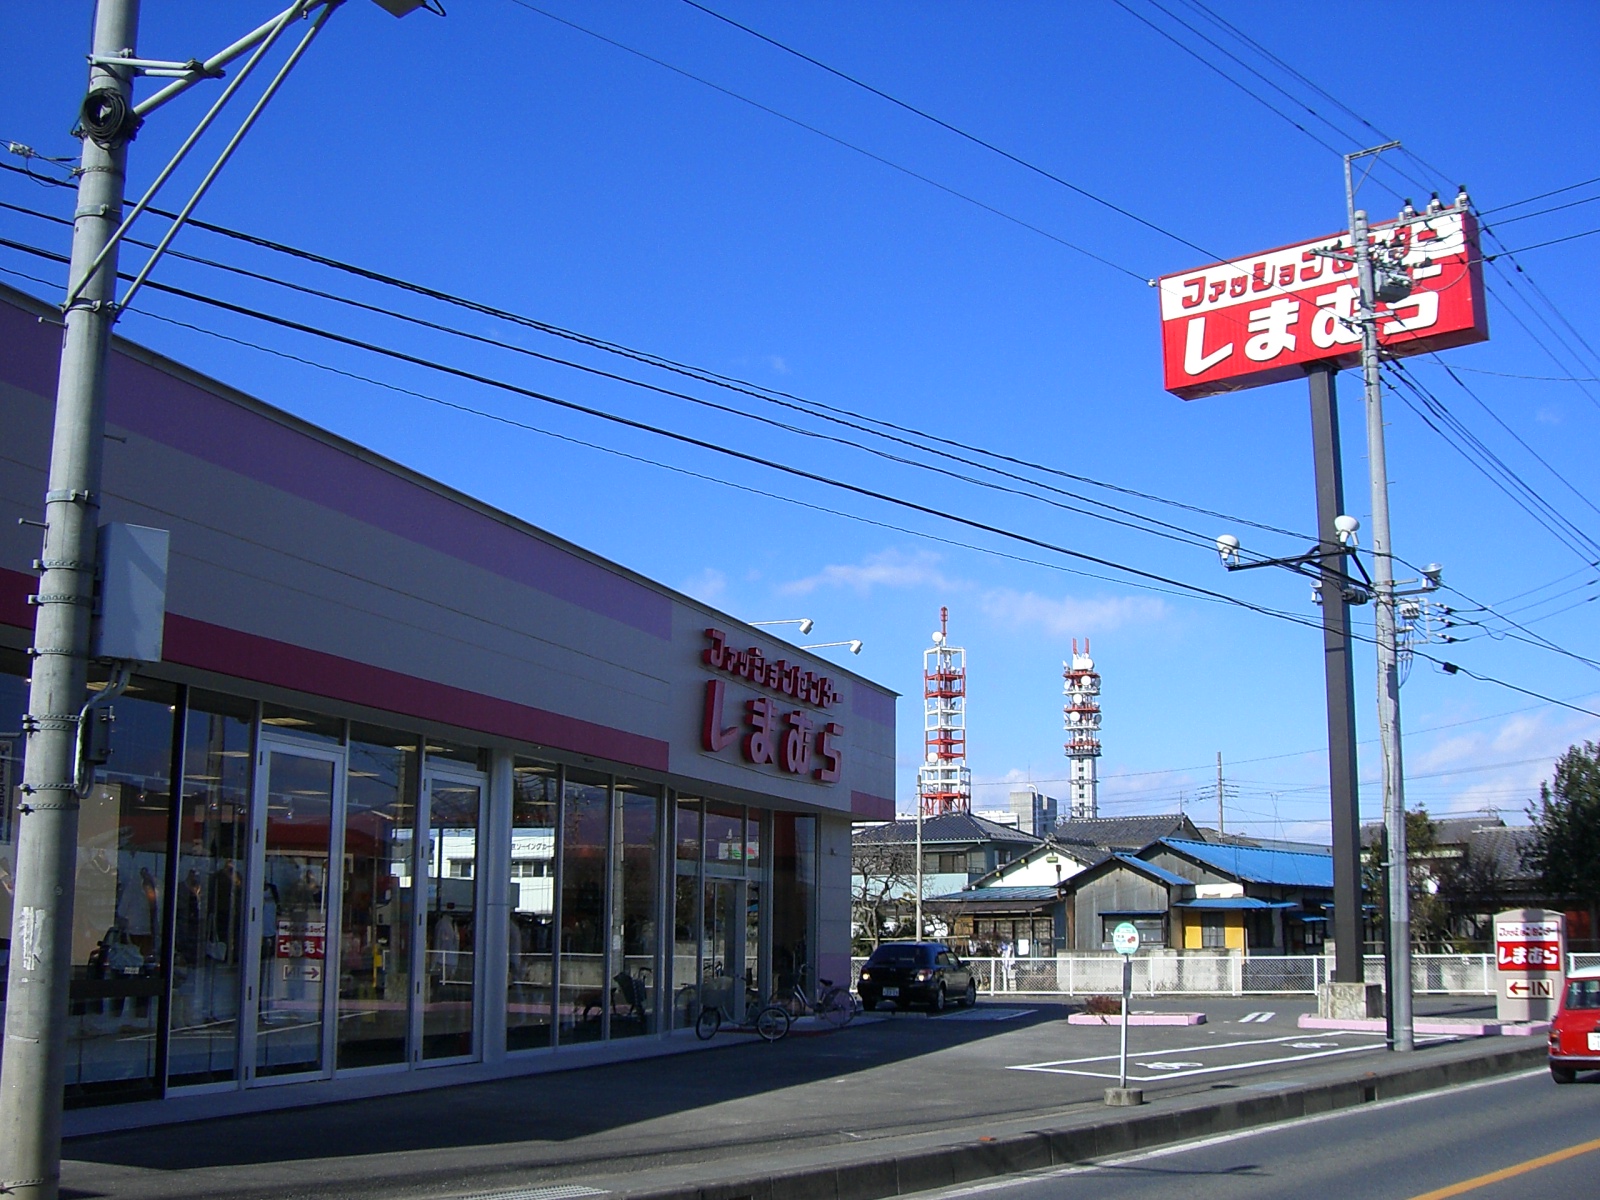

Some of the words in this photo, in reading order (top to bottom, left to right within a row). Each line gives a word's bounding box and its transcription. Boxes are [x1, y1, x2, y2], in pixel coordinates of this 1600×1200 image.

[1184, 263, 1441, 376] しまむら
[703, 628, 844, 709] ファッションセンター
[703, 679, 844, 783] しまむら
[1499, 946, 1557, 965] しまむら
[1532, 981, 1550, 995] IN
